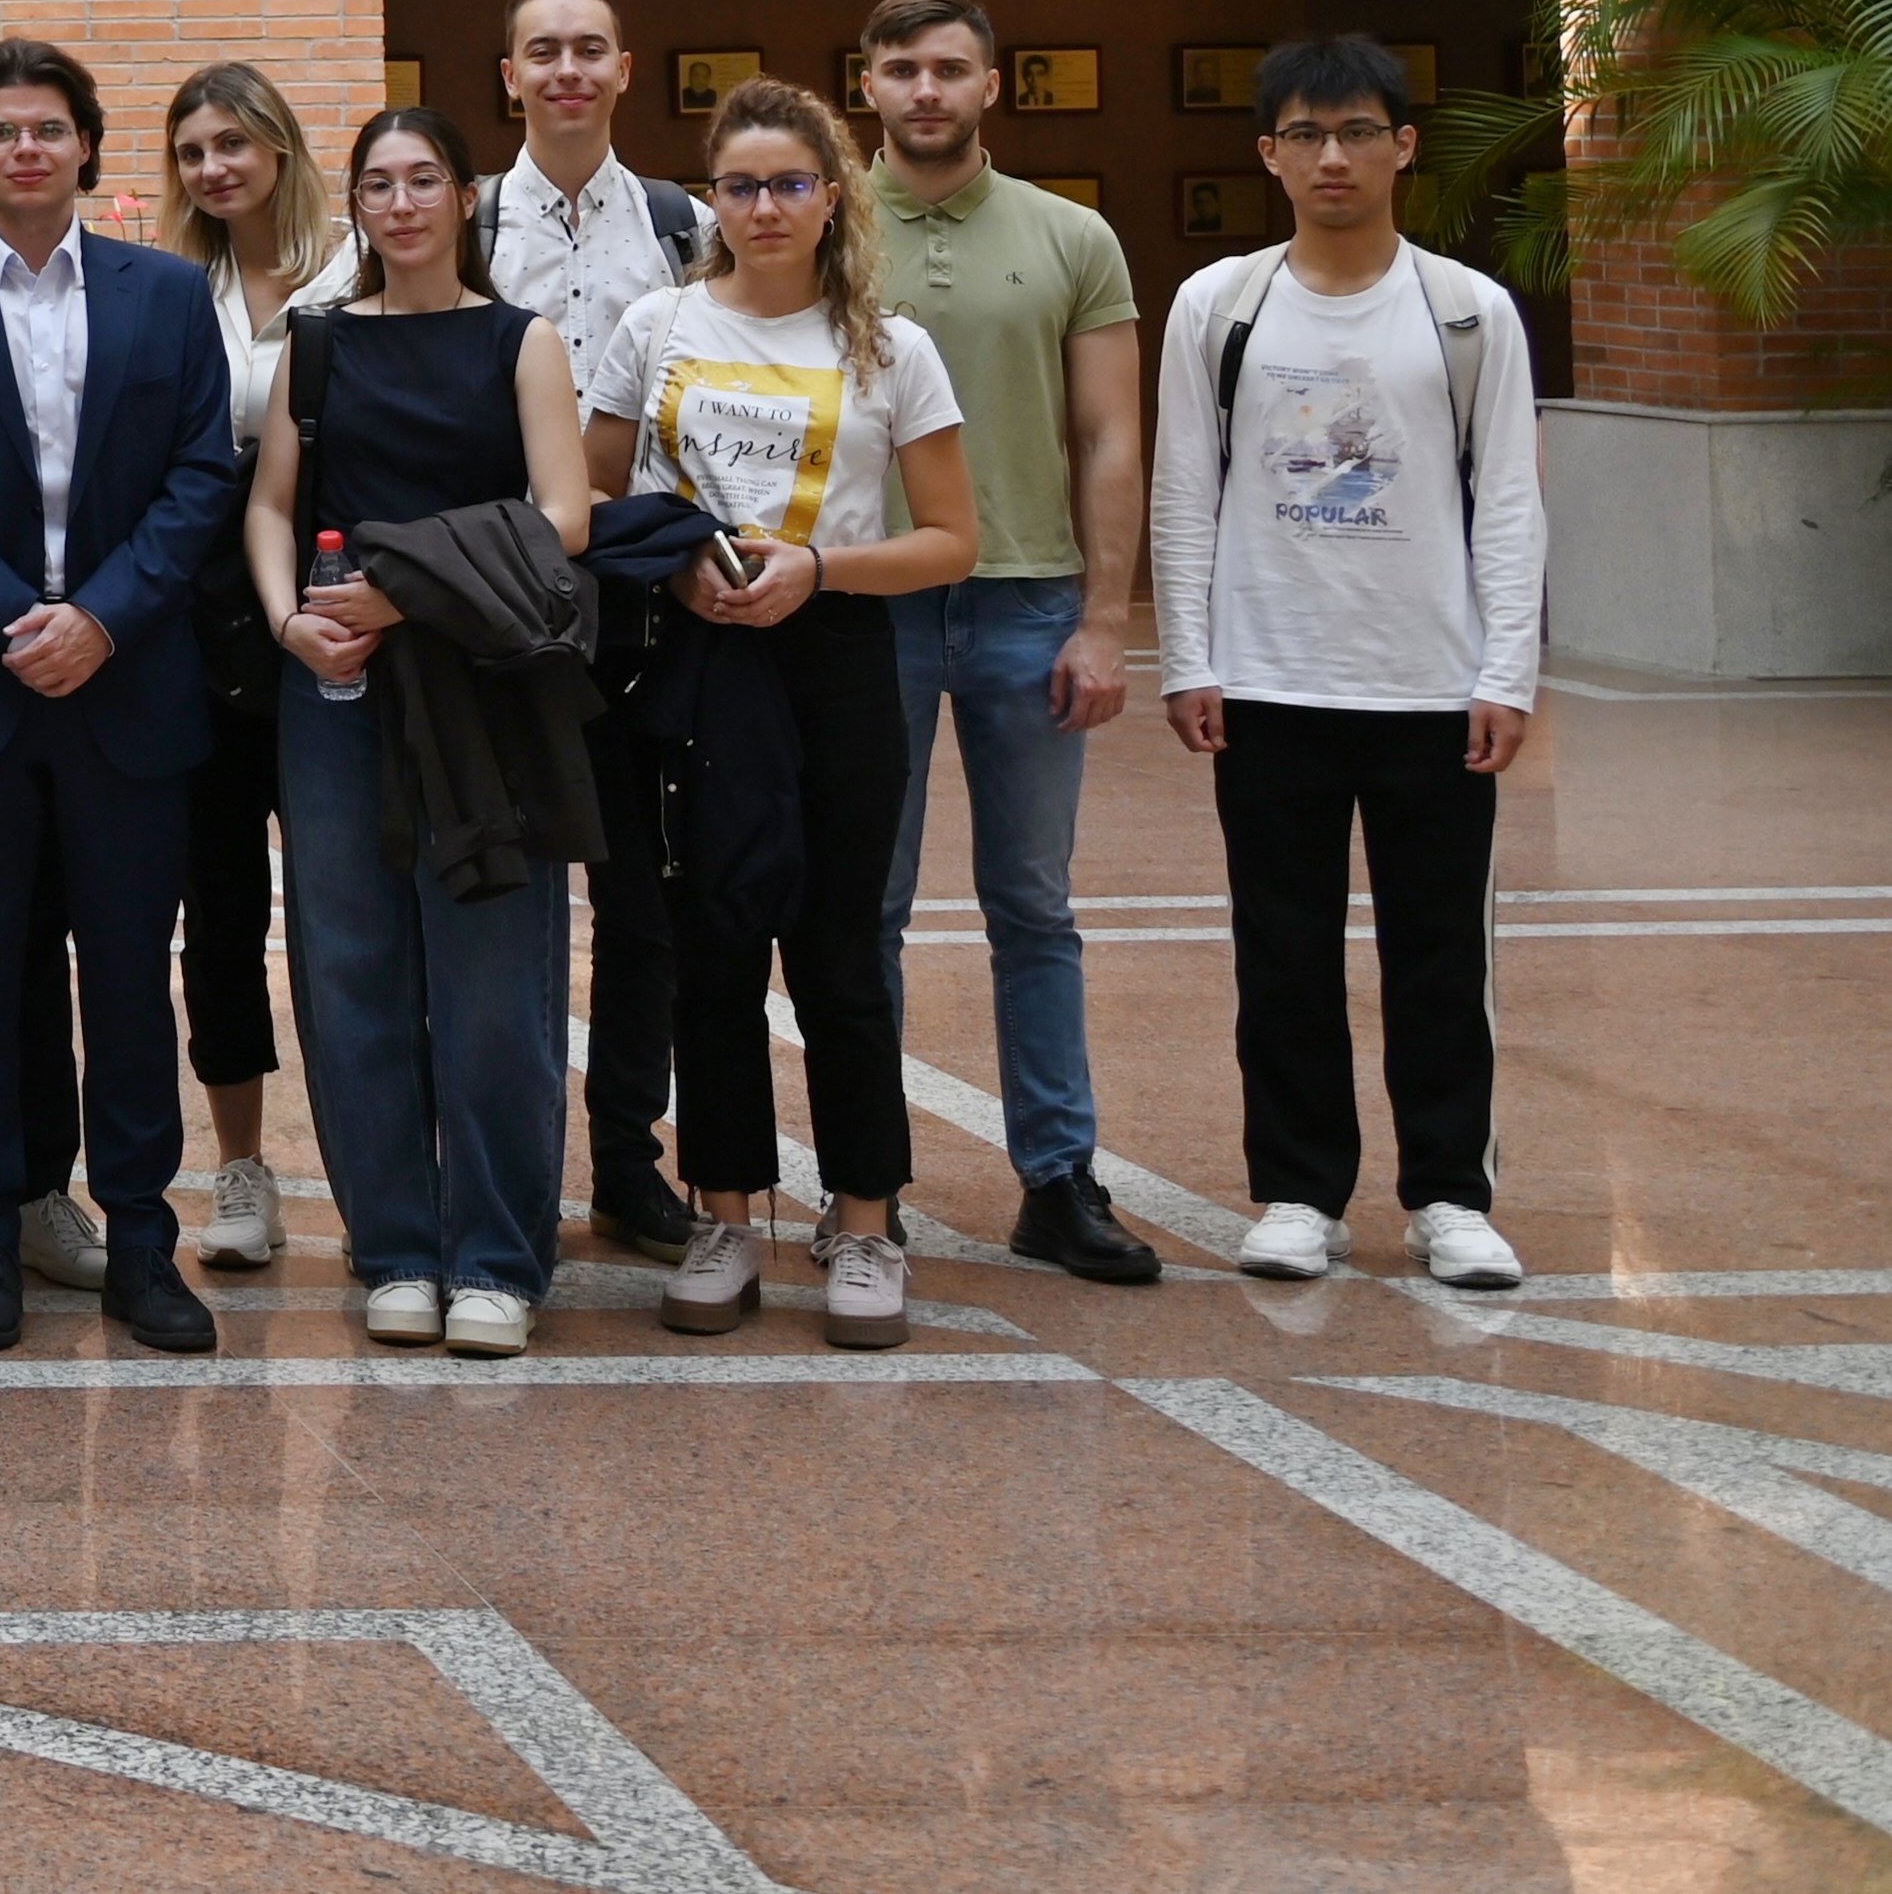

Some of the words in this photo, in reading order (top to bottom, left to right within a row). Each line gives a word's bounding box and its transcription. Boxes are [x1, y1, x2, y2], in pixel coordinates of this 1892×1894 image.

[698, 400, 704, 413] I
[710, 401, 763, 419] WANT
[768, 409, 792, 422] TO
[667, 426, 827, 467] inspire
[1276, 503, 1387, 526] POPULAR
